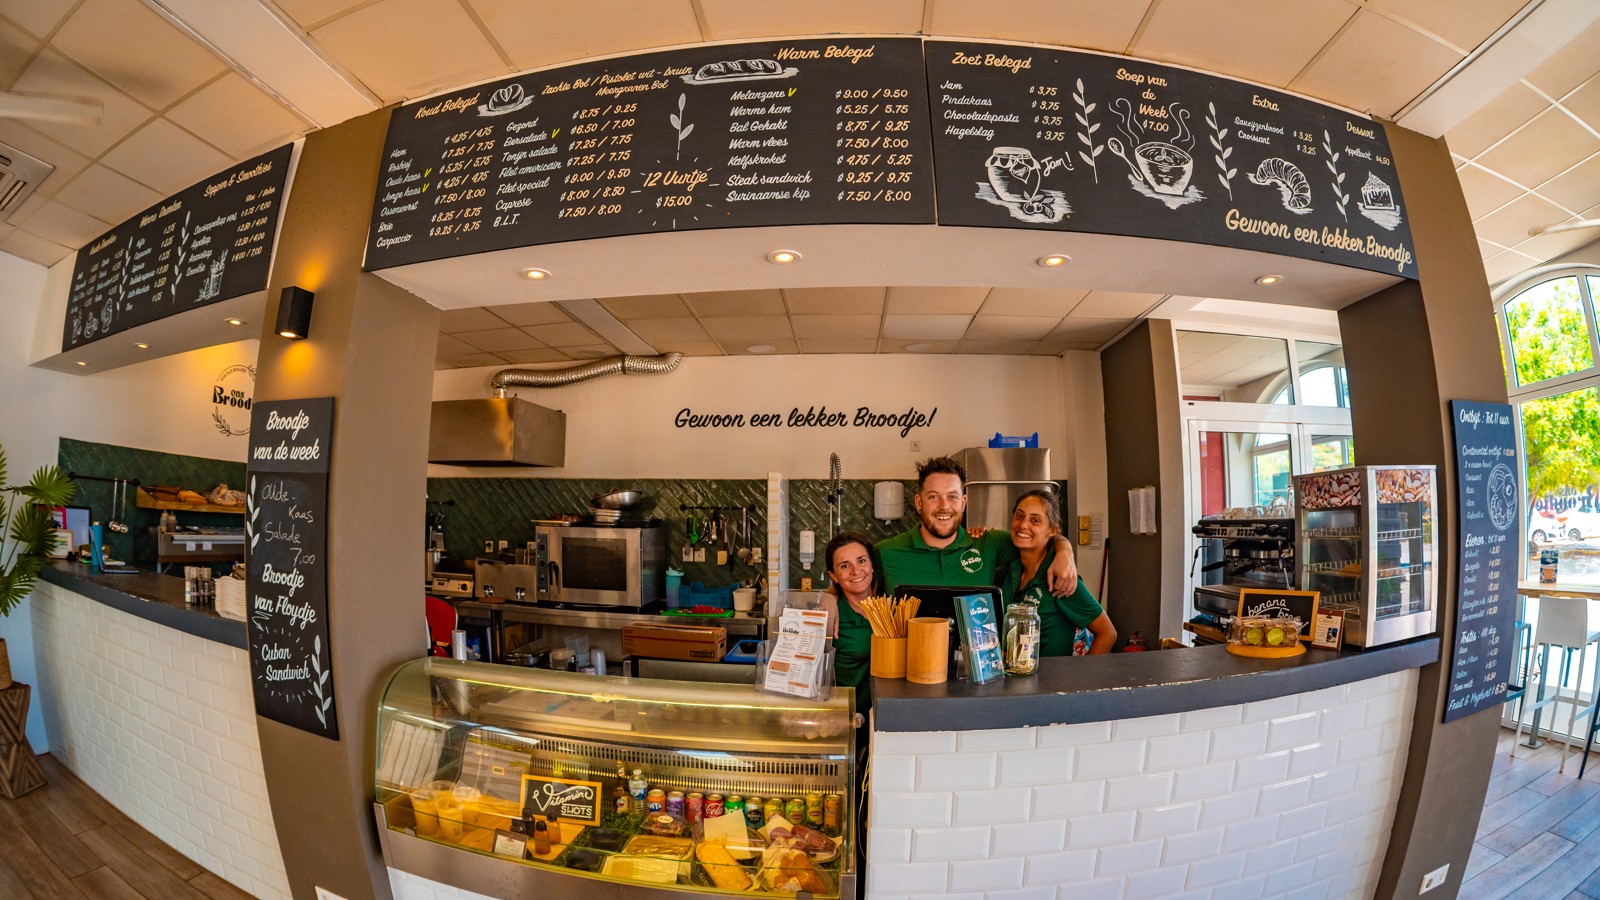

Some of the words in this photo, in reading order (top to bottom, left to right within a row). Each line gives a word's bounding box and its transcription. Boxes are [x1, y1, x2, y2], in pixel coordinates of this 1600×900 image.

[777, 48, 820, 60] Warm
[824, 45, 875, 64] Belegd
[952, 52, 982, 66] Zoet
[984, 54, 1032, 73] Belegd
[542, 82, 572, 96] Zachte
[572, 78, 589, 90] Bol
[600, 70, 636, 86] Pistolet
[664, 66, 693, 77] bruin
[651, 80, 669, 90] Bol
[940, 80, 963, 90] Jam
[1116, 68, 1144, 84] Soep
[1147, 76, 1167, 86] van
[730, 89, 785, 102] Melanzane
[942, 95, 992, 106] Pindakaas
[1142, 89, 1156, 100] de
[415, 102, 441, 119] Koud
[440, 92, 480, 113] Belegd
[730, 106, 766, 116] Warme
[768, 104, 792, 114] ham
[1139, 103, 1169, 119] Week
[1252, 95, 1279, 112] Extra
[506, 118, 539, 132] Gezond
[944, 110, 1019, 124] Chocoladepasta
[730, 122, 748, 133] Bal
[750, 119, 788, 131] Gehakt
[945, 125, 994, 141] Hagelslag
[1346, 121, 1376, 140] Dessert
[503, 132, 547, 147] Eiersalade
[729, 138, 760, 149] Warm
[761, 137, 788, 148] vlees
[1238, 130, 1271, 145] Croissant
[528, 144, 558, 157] salade
[498, 164, 519, 178] Filet
[518, 160, 562, 174] americain
[728, 154, 786, 168] Kalfskroket
[496, 181, 516, 195] Filet
[516, 176, 550, 194] special
[643, 172, 662, 188] 12
[664, 171, 708, 192] Uurtje
[726, 175, 759, 186] Steak
[760, 171, 813, 185] sandwich
[726, 190, 790, 202] Surinaamse
[793, 188, 810, 201] kip
[495, 197, 532, 212] Caprese
[493, 214, 521, 228] B.L.T.
[376, 233, 413, 249] Carpaccio
[1225, 208, 1291, 240] Gewoon
[1294, 226, 1321, 245] een
[1321, 226, 1365, 254] lekker
[1366, 235, 1412, 273] Broodje
[231, 389, 244, 398] ons
[266, 409, 310, 440] Broodje
[674, 408, 745, 428] Gewoon
[750, 413, 782, 427] een
[787, 406, 848, 427] lekker
[853, 407, 938, 438] Broodje!
[253, 445, 273, 460] van
[274, 440, 288, 460] de
[290, 438, 320, 460] week
[288, 504, 314, 523] Kaas
[264, 522, 301, 544] Salade
[262, 563, 305, 597] Broodje
[254, 594, 273, 613] van
[275, 596, 317, 630] Floydje
[1248, 599, 1287, 616] banana
[262, 643, 292, 661] Cuban
[266, 660, 310, 682] Sandwich
[532, 783, 594, 812] Vitamine
[561, 805, 592, 816] SHOTS
